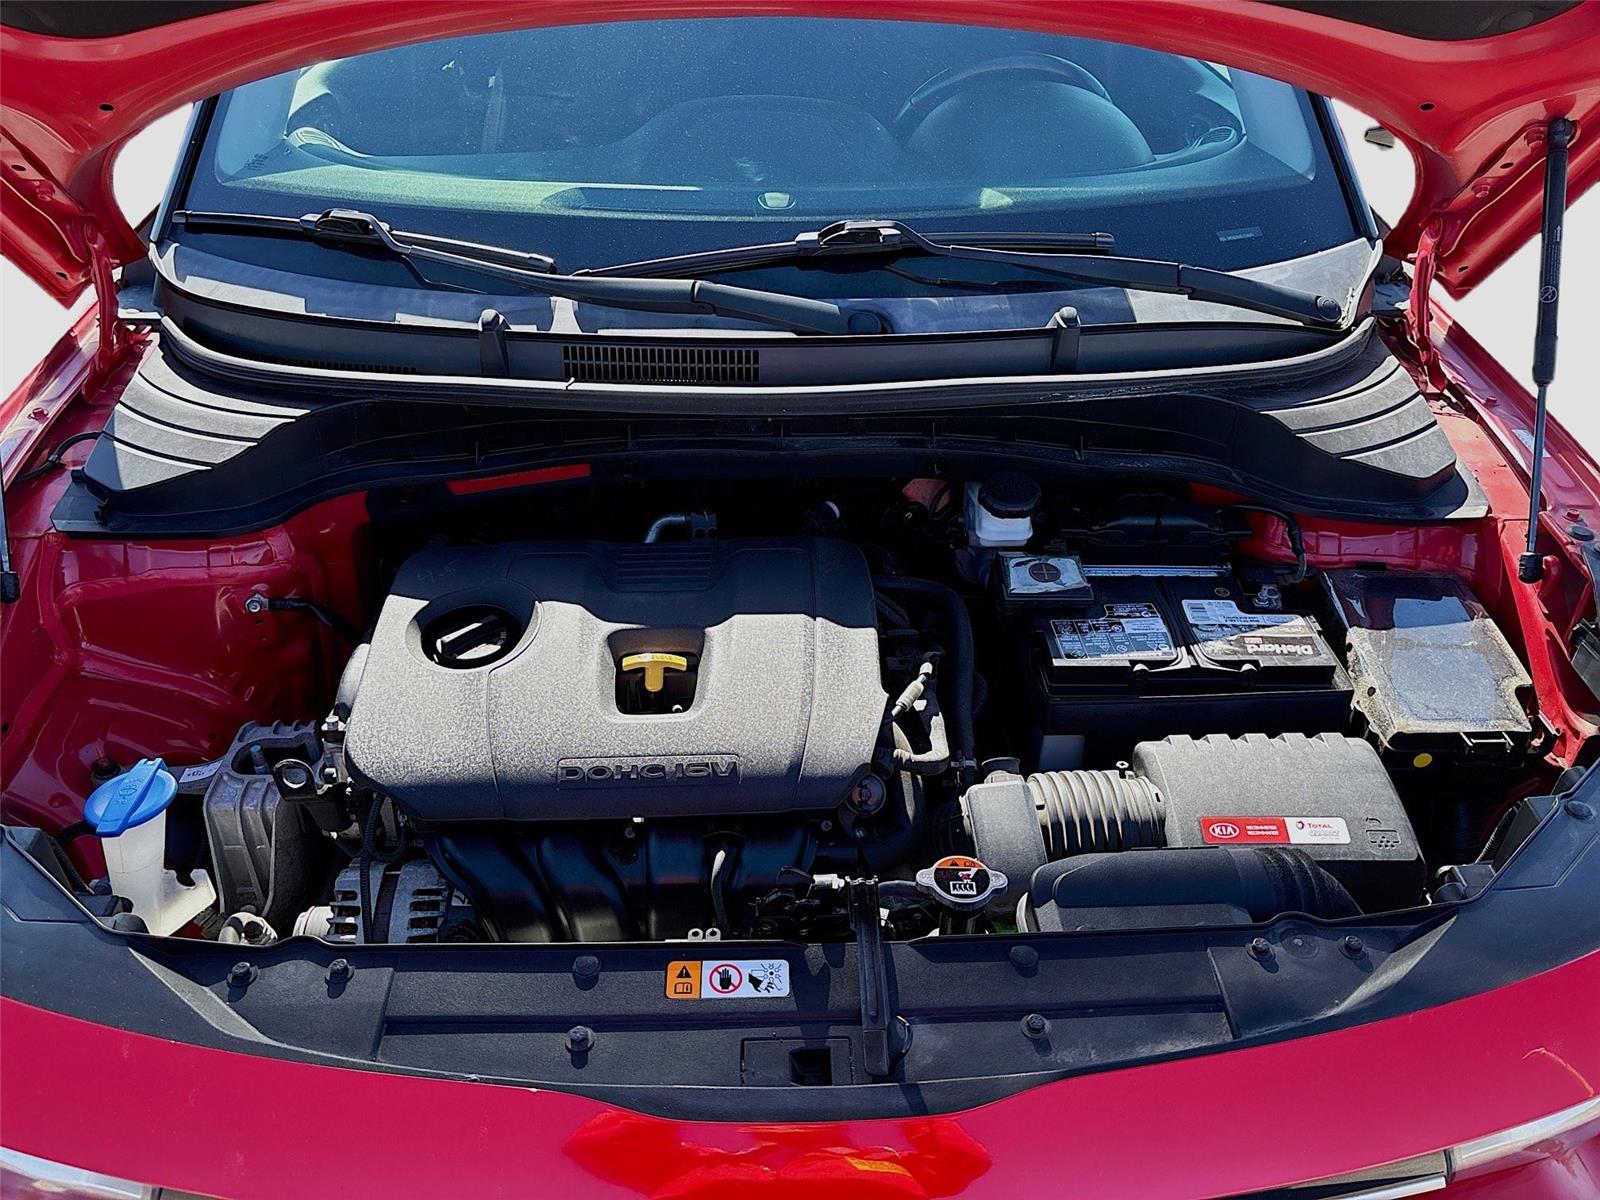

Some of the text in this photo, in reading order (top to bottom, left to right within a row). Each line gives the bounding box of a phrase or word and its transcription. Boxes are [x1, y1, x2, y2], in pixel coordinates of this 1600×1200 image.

[1248, 644, 1313, 655] DieHard
[560, 761, 737, 782] DOHC 16V
[1214, 825, 1236, 836] KIA
[1307, 822, 1332, 830] TOTAL
